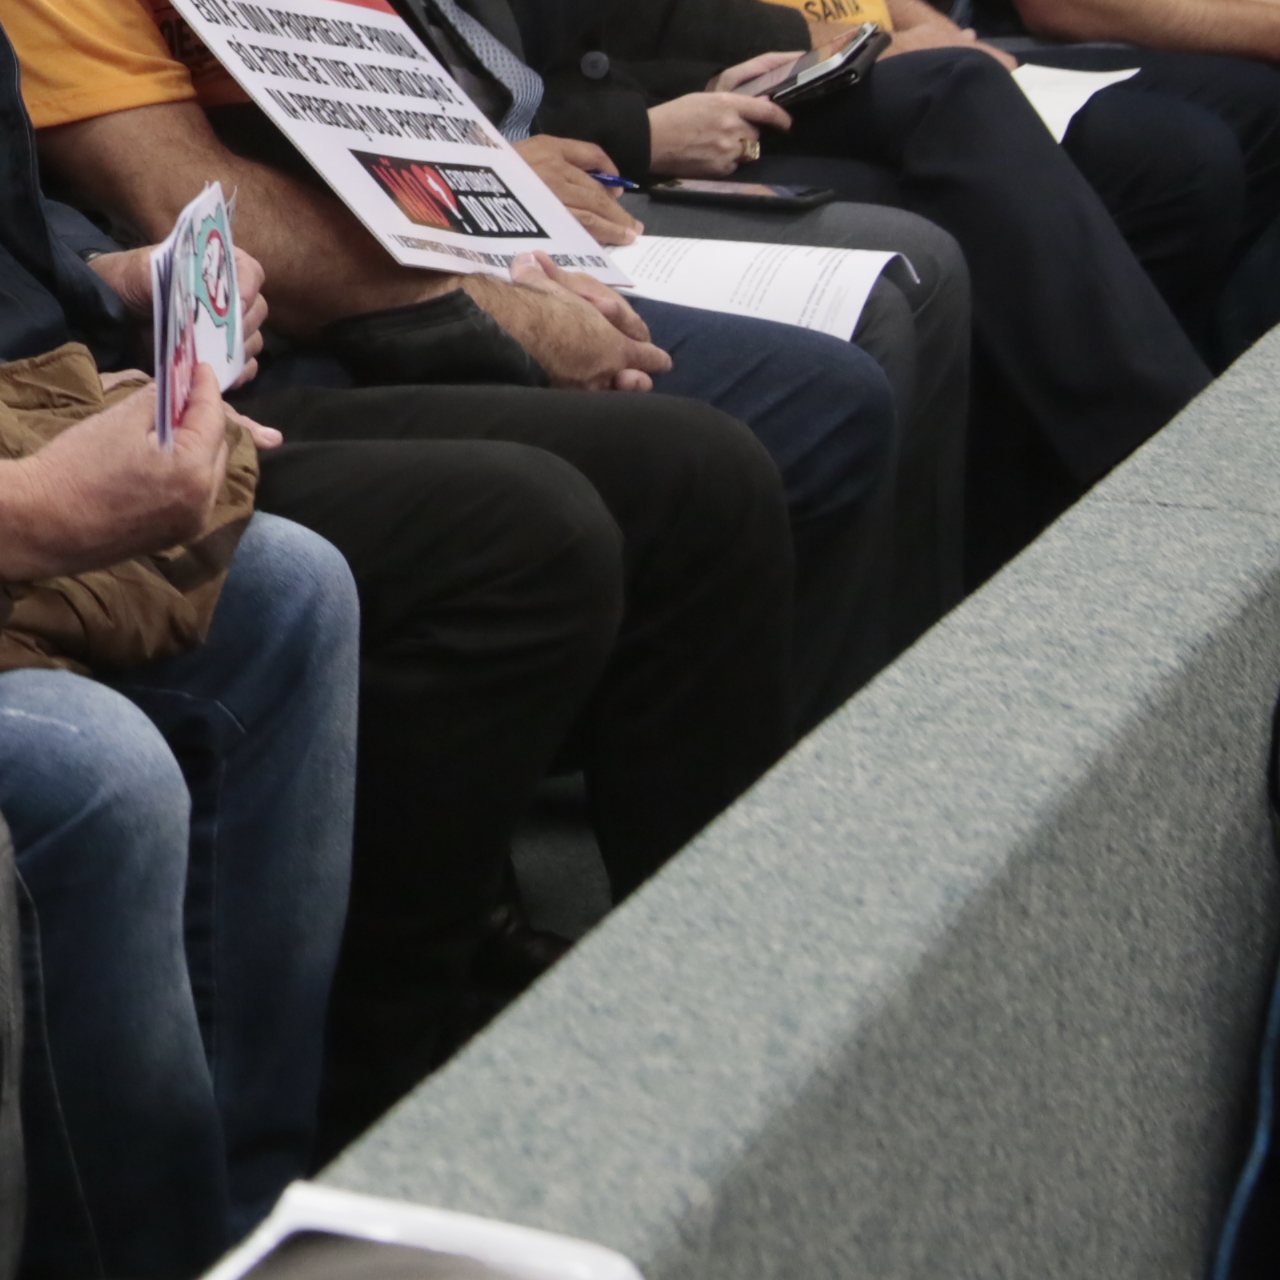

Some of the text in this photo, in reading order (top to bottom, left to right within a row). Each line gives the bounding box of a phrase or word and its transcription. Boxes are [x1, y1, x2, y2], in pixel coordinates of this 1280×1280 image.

[232, 0, 284, 37] UMA
[266, 7, 372, 51] PROPRIEDADE
[226, 34, 266, 74] SÓ
[248, 43, 310, 82] ENTRE
[293, 52, 329, 85] SE
[438, 76, 464, 106] E
[263, 86, 307, 122] NA
[357, 104, 403, 138] DOS
[458, 195, 539, 233] DO XISTO
